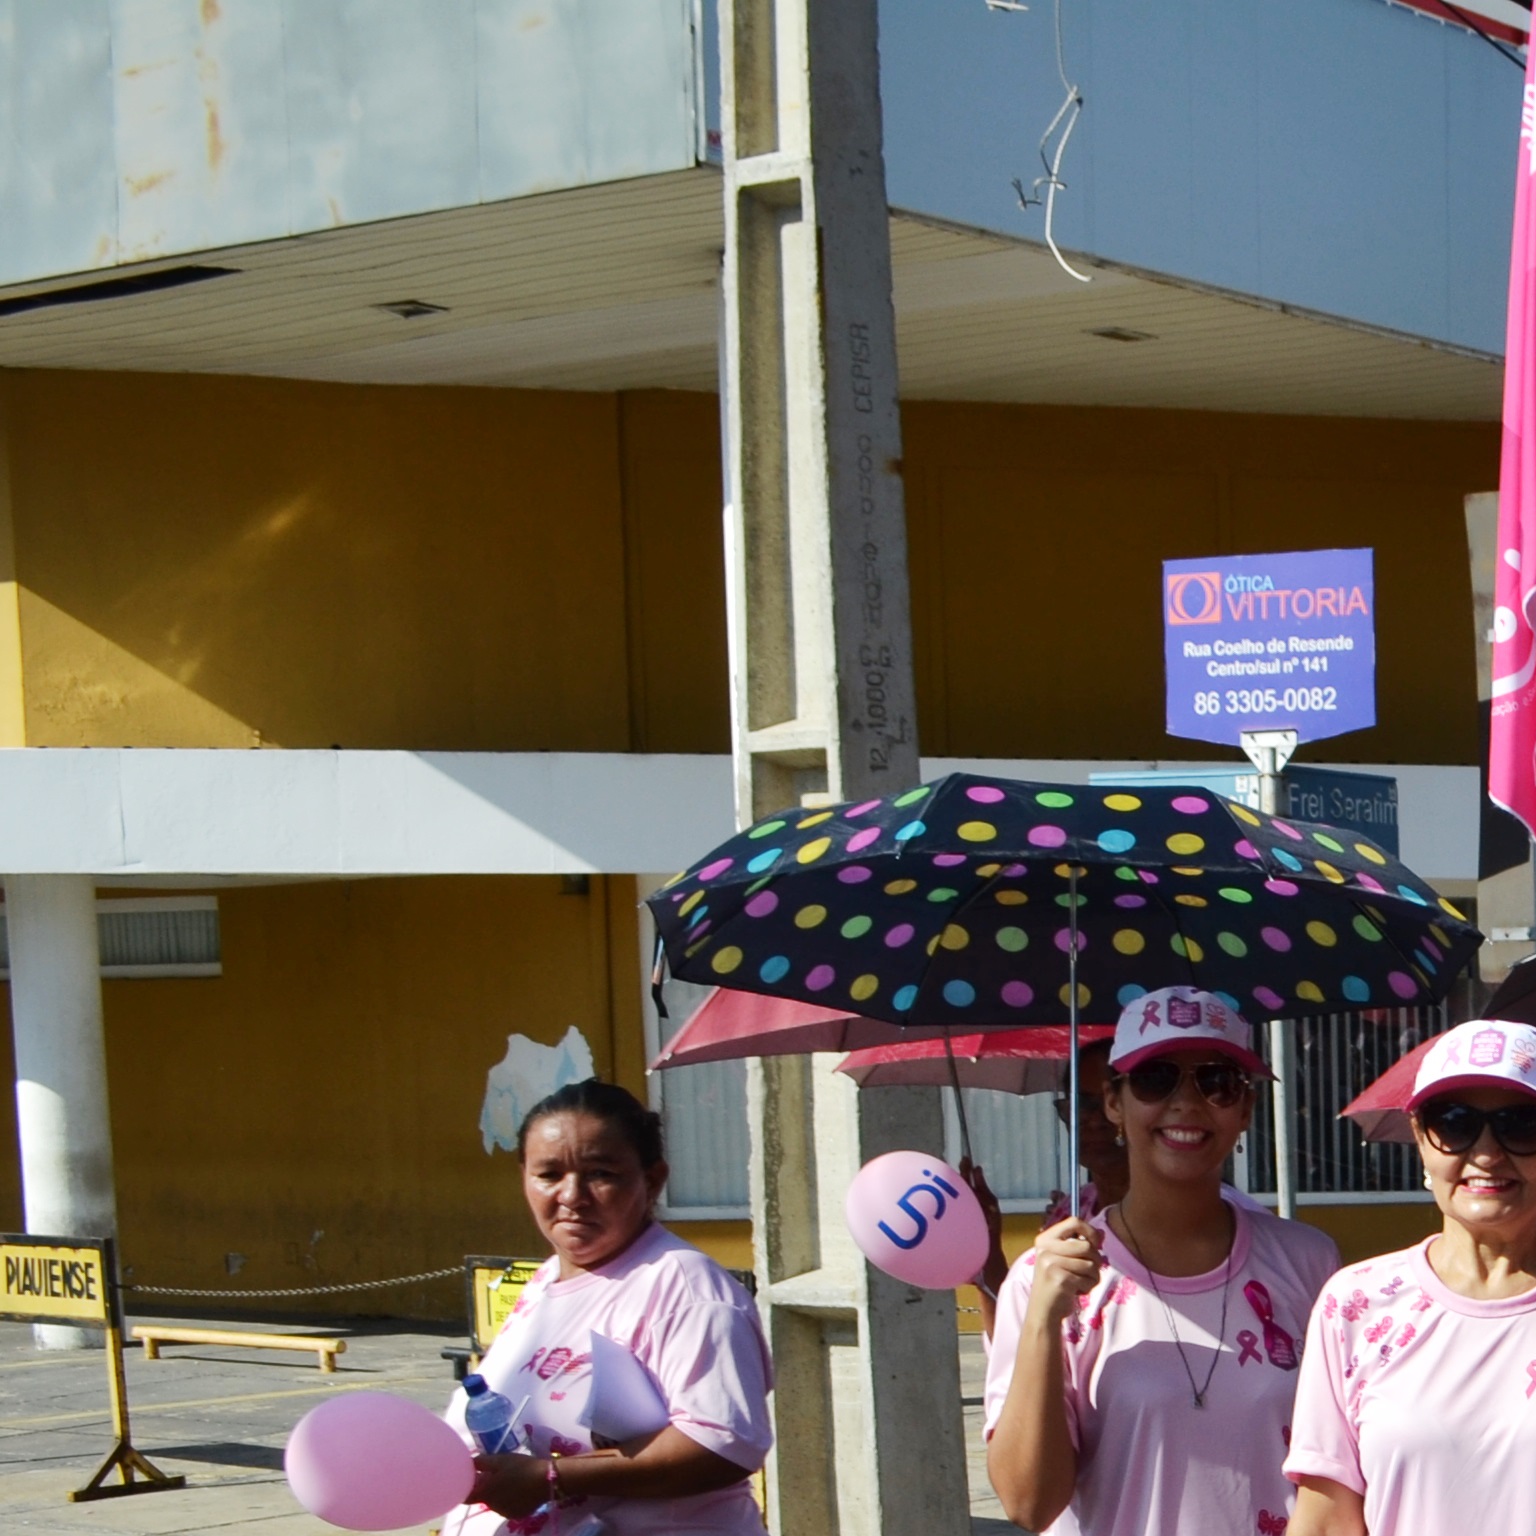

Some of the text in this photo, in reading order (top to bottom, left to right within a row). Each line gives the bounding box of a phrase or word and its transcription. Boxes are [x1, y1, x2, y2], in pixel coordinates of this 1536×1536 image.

[849, 322, 874, 415] CEPISA
[1225, 587, 1368, 622] VITTORIA
[1183, 635, 1353, 658] Rua Coelho de Resende
[1207, 659, 1280, 677] Centro/sul
[1302, 657, 1328, 673] 141
[1194, 687, 1337, 715] 86 3305-0082
[1288, 784, 1324, 819] Frei
[1330, 788, 1398, 825] Serafim
